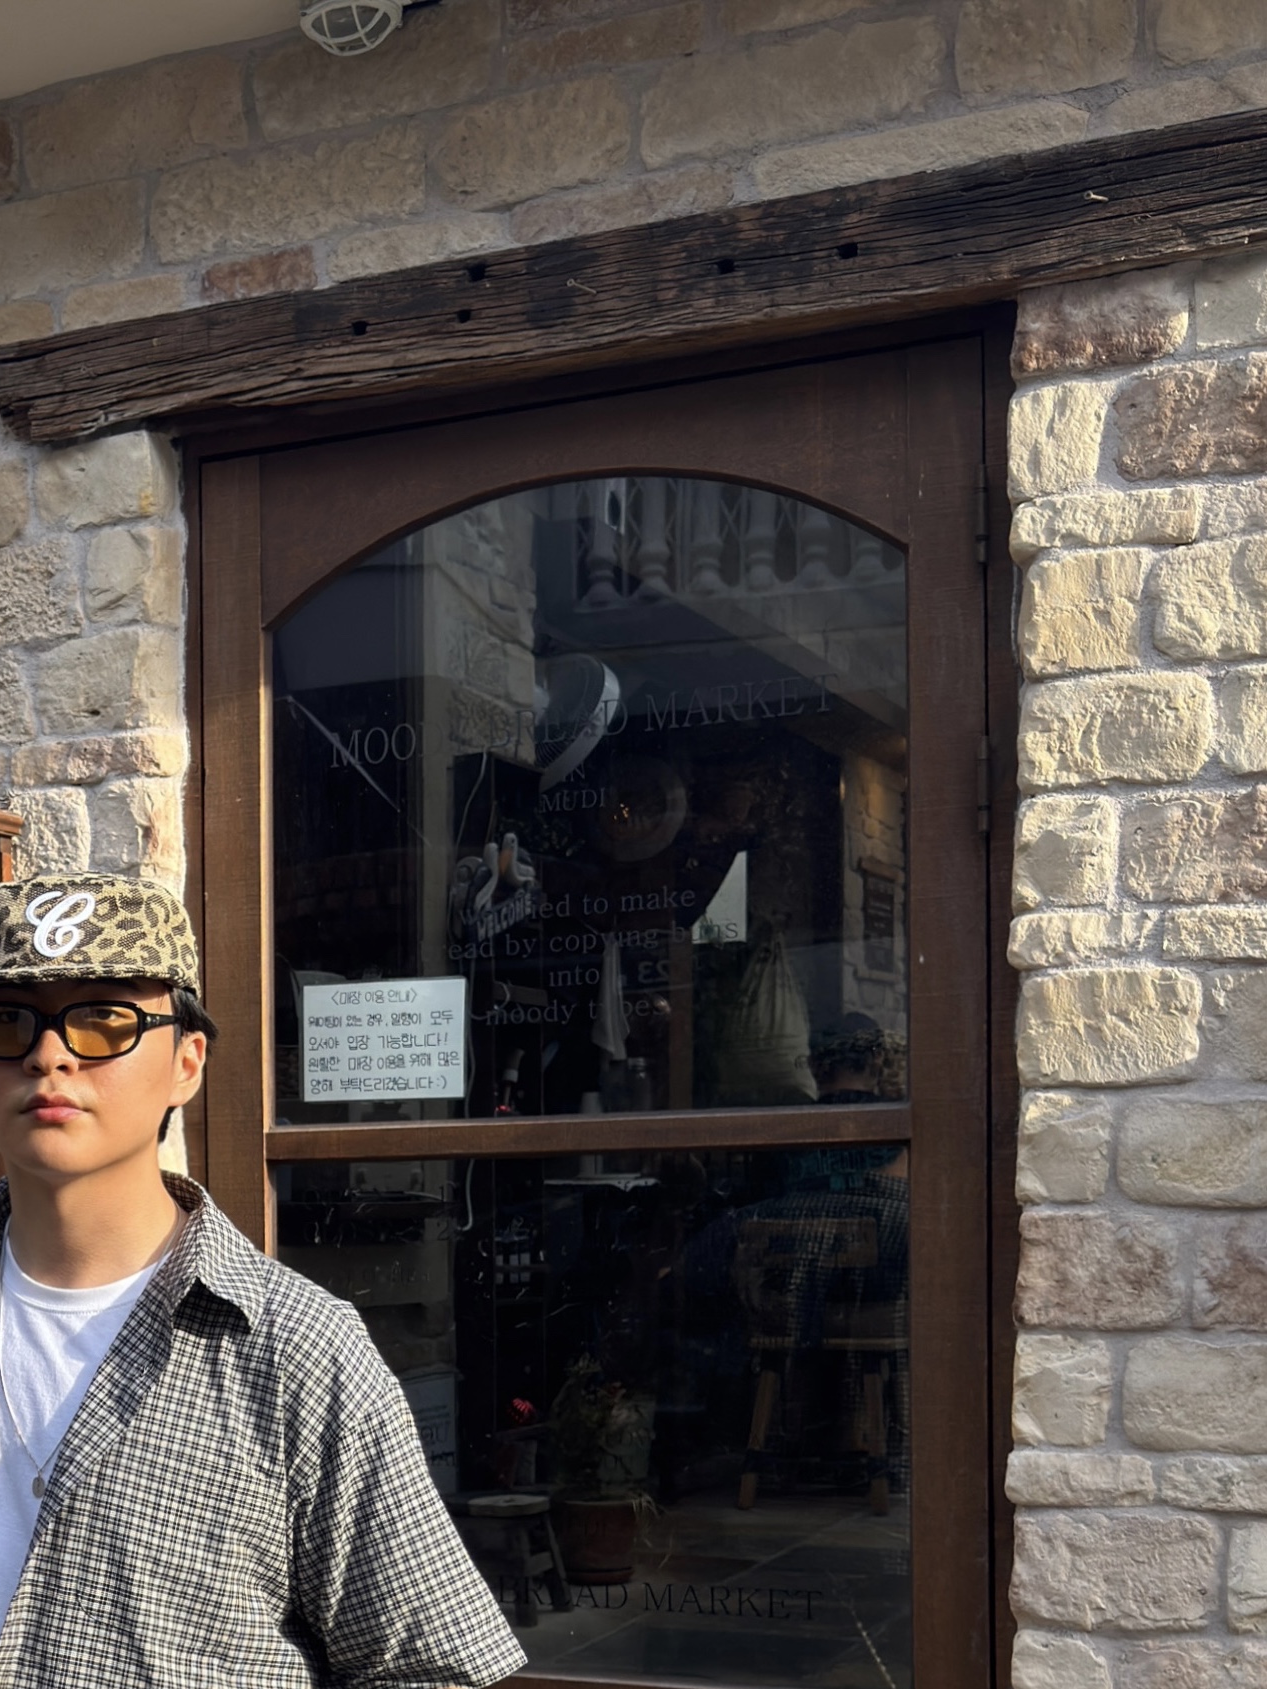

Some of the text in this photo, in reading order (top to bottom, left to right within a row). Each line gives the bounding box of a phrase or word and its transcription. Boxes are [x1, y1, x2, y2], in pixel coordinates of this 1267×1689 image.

[644, 672, 841, 733] MARKET
[538, 787, 606, 814] MUDI
[582, 896, 609, 916] to
[619, 884, 696, 913] make
[26, 891, 95, 957] C
[505, 933, 538, 959] by
[548, 962, 601, 988] into
[364, 989, 385, 1004] 이용
[345, 1014, 363, 1028] 있는
[390, 1011, 422, 1027] 일행이
[430, 1009, 454, 1026] 모두
[485, 1001, 577, 1026] moody
[346, 1034, 371, 1051] 입장
[377, 1032, 449, 1050] 가능합니다!
[307, 1050, 461, 1073] 원활한 매장 이용을 위해 많은
[310, 1078, 333, 1095] 양해
[643, 1581, 825, 1622] MARKET
